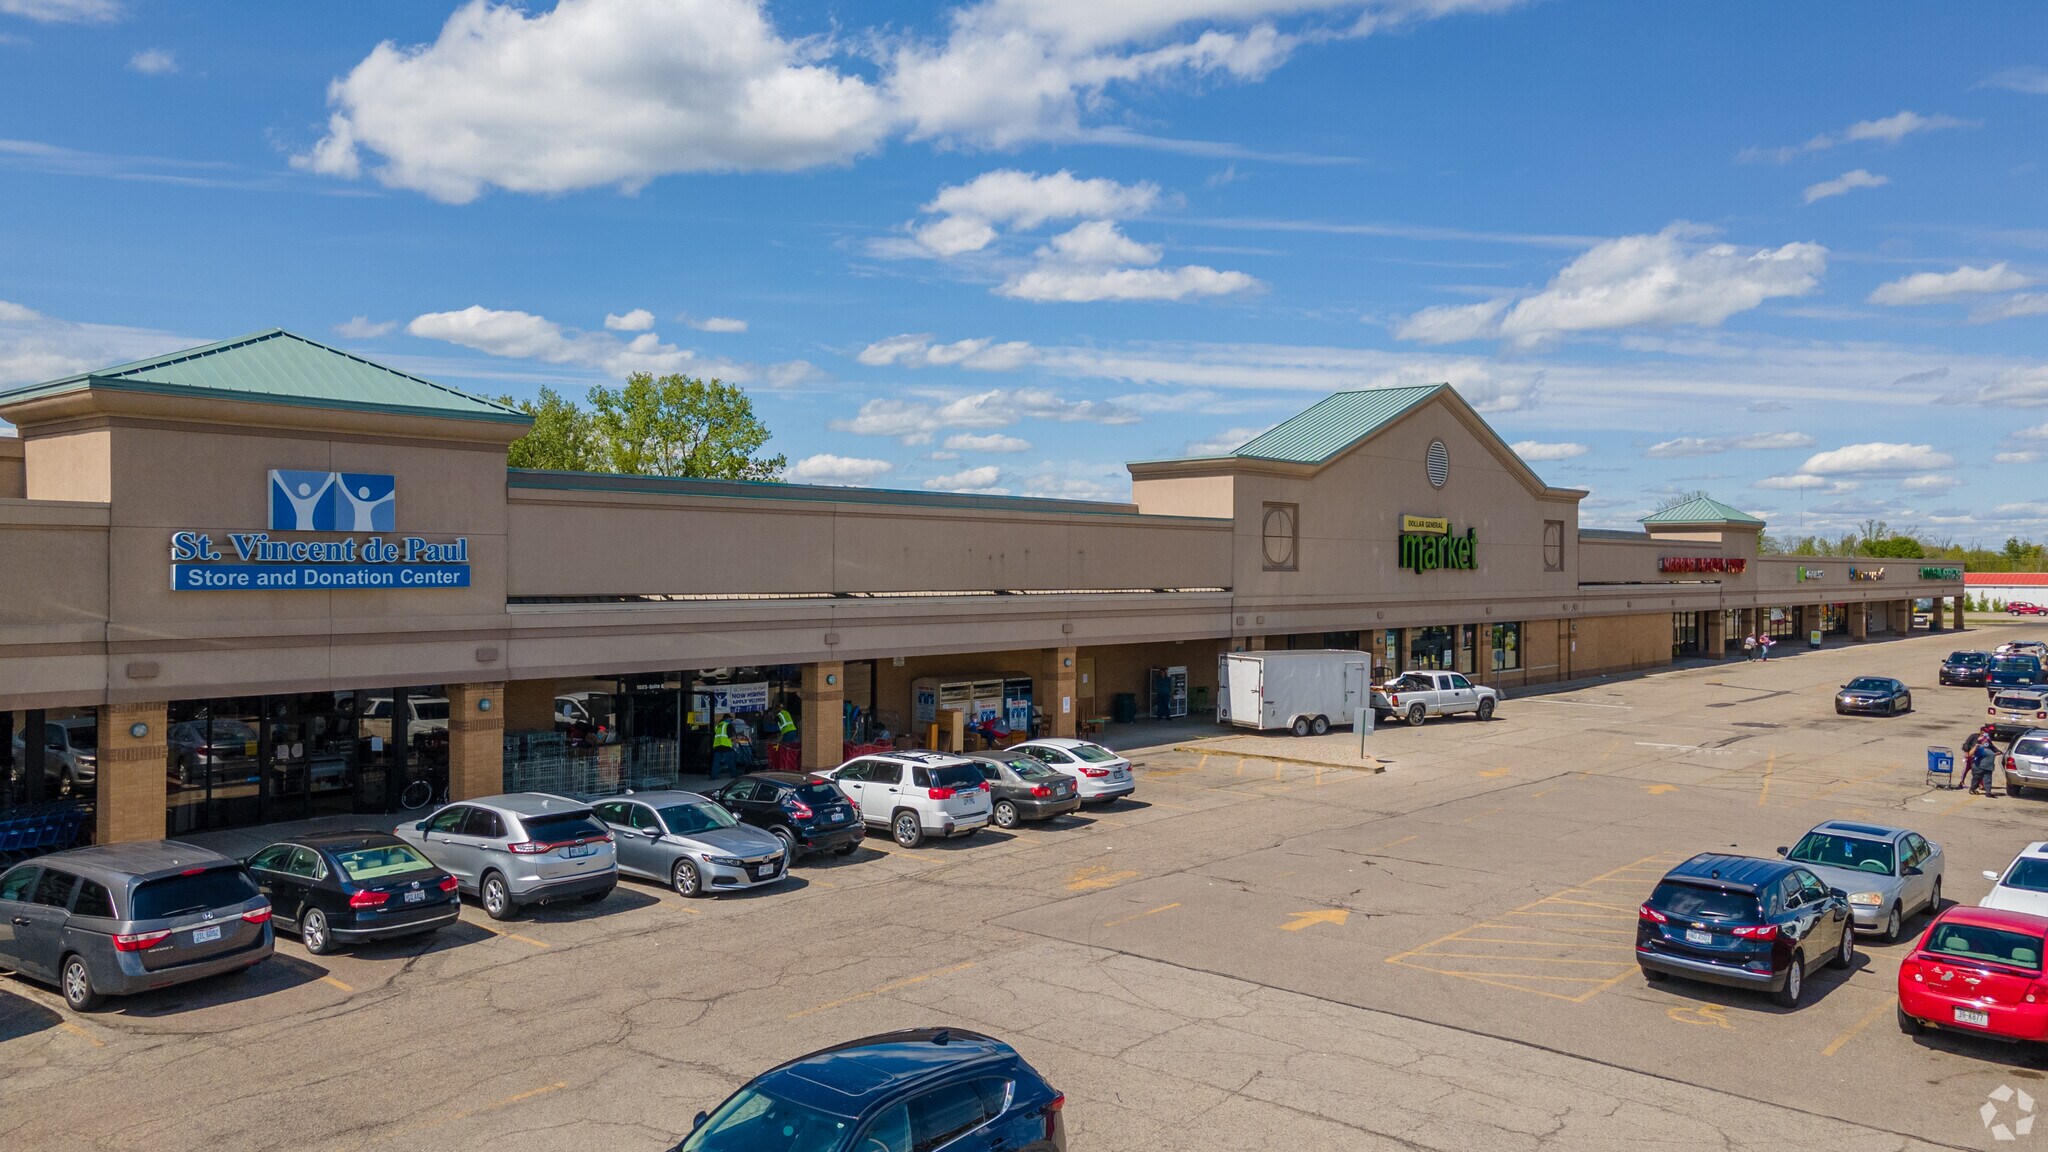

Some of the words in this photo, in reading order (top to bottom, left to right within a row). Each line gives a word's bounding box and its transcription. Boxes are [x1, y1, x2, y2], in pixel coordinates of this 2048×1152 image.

[1408, 520, 1424, 528] DOLLAR
[1425, 521, 1443, 529] GENERAL
[172, 531, 222, 561] St.
[227, 533, 357, 562] Vincent
[361, 536, 399, 562] de
[403, 537, 468, 562] Paul
[1400, 523, 1478, 574] market
[188, 569, 249, 586] Store
[256, 569, 297, 585] and
[304, 569, 394, 585] Donation
[400, 569, 460, 584] Center
